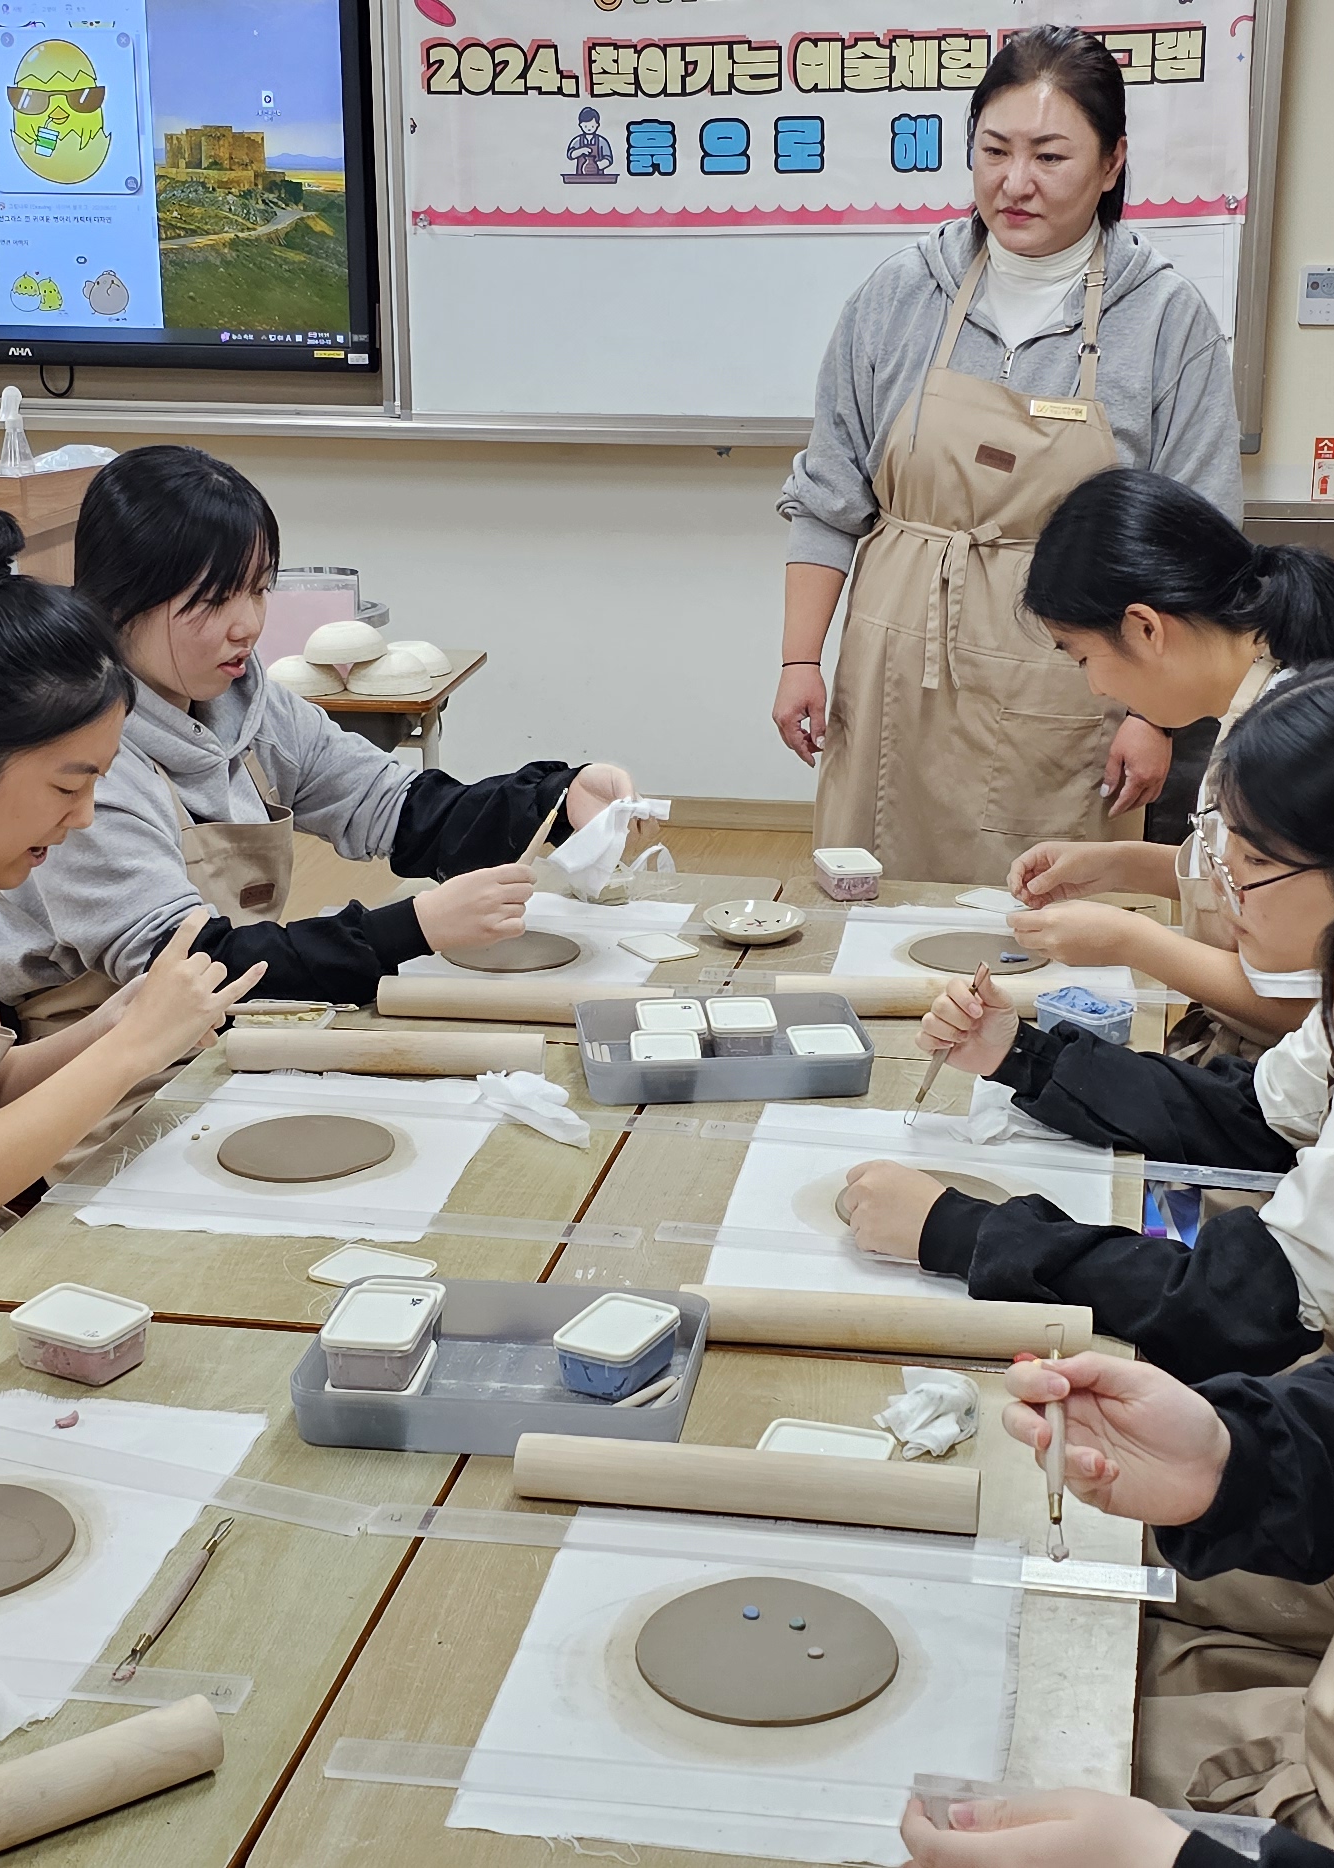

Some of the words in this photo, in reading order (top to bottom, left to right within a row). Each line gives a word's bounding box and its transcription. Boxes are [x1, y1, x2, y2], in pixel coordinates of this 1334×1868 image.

[423, 41, 580, 98] 2024.
[589, 38, 782, 98] 찾아가는
[792, 34, 992, 94] 예술체험
[997, 25, 1207, 87] 그램
[626, 115, 825, 177] 흙으로
[8, 347, 32, 356] AHA
